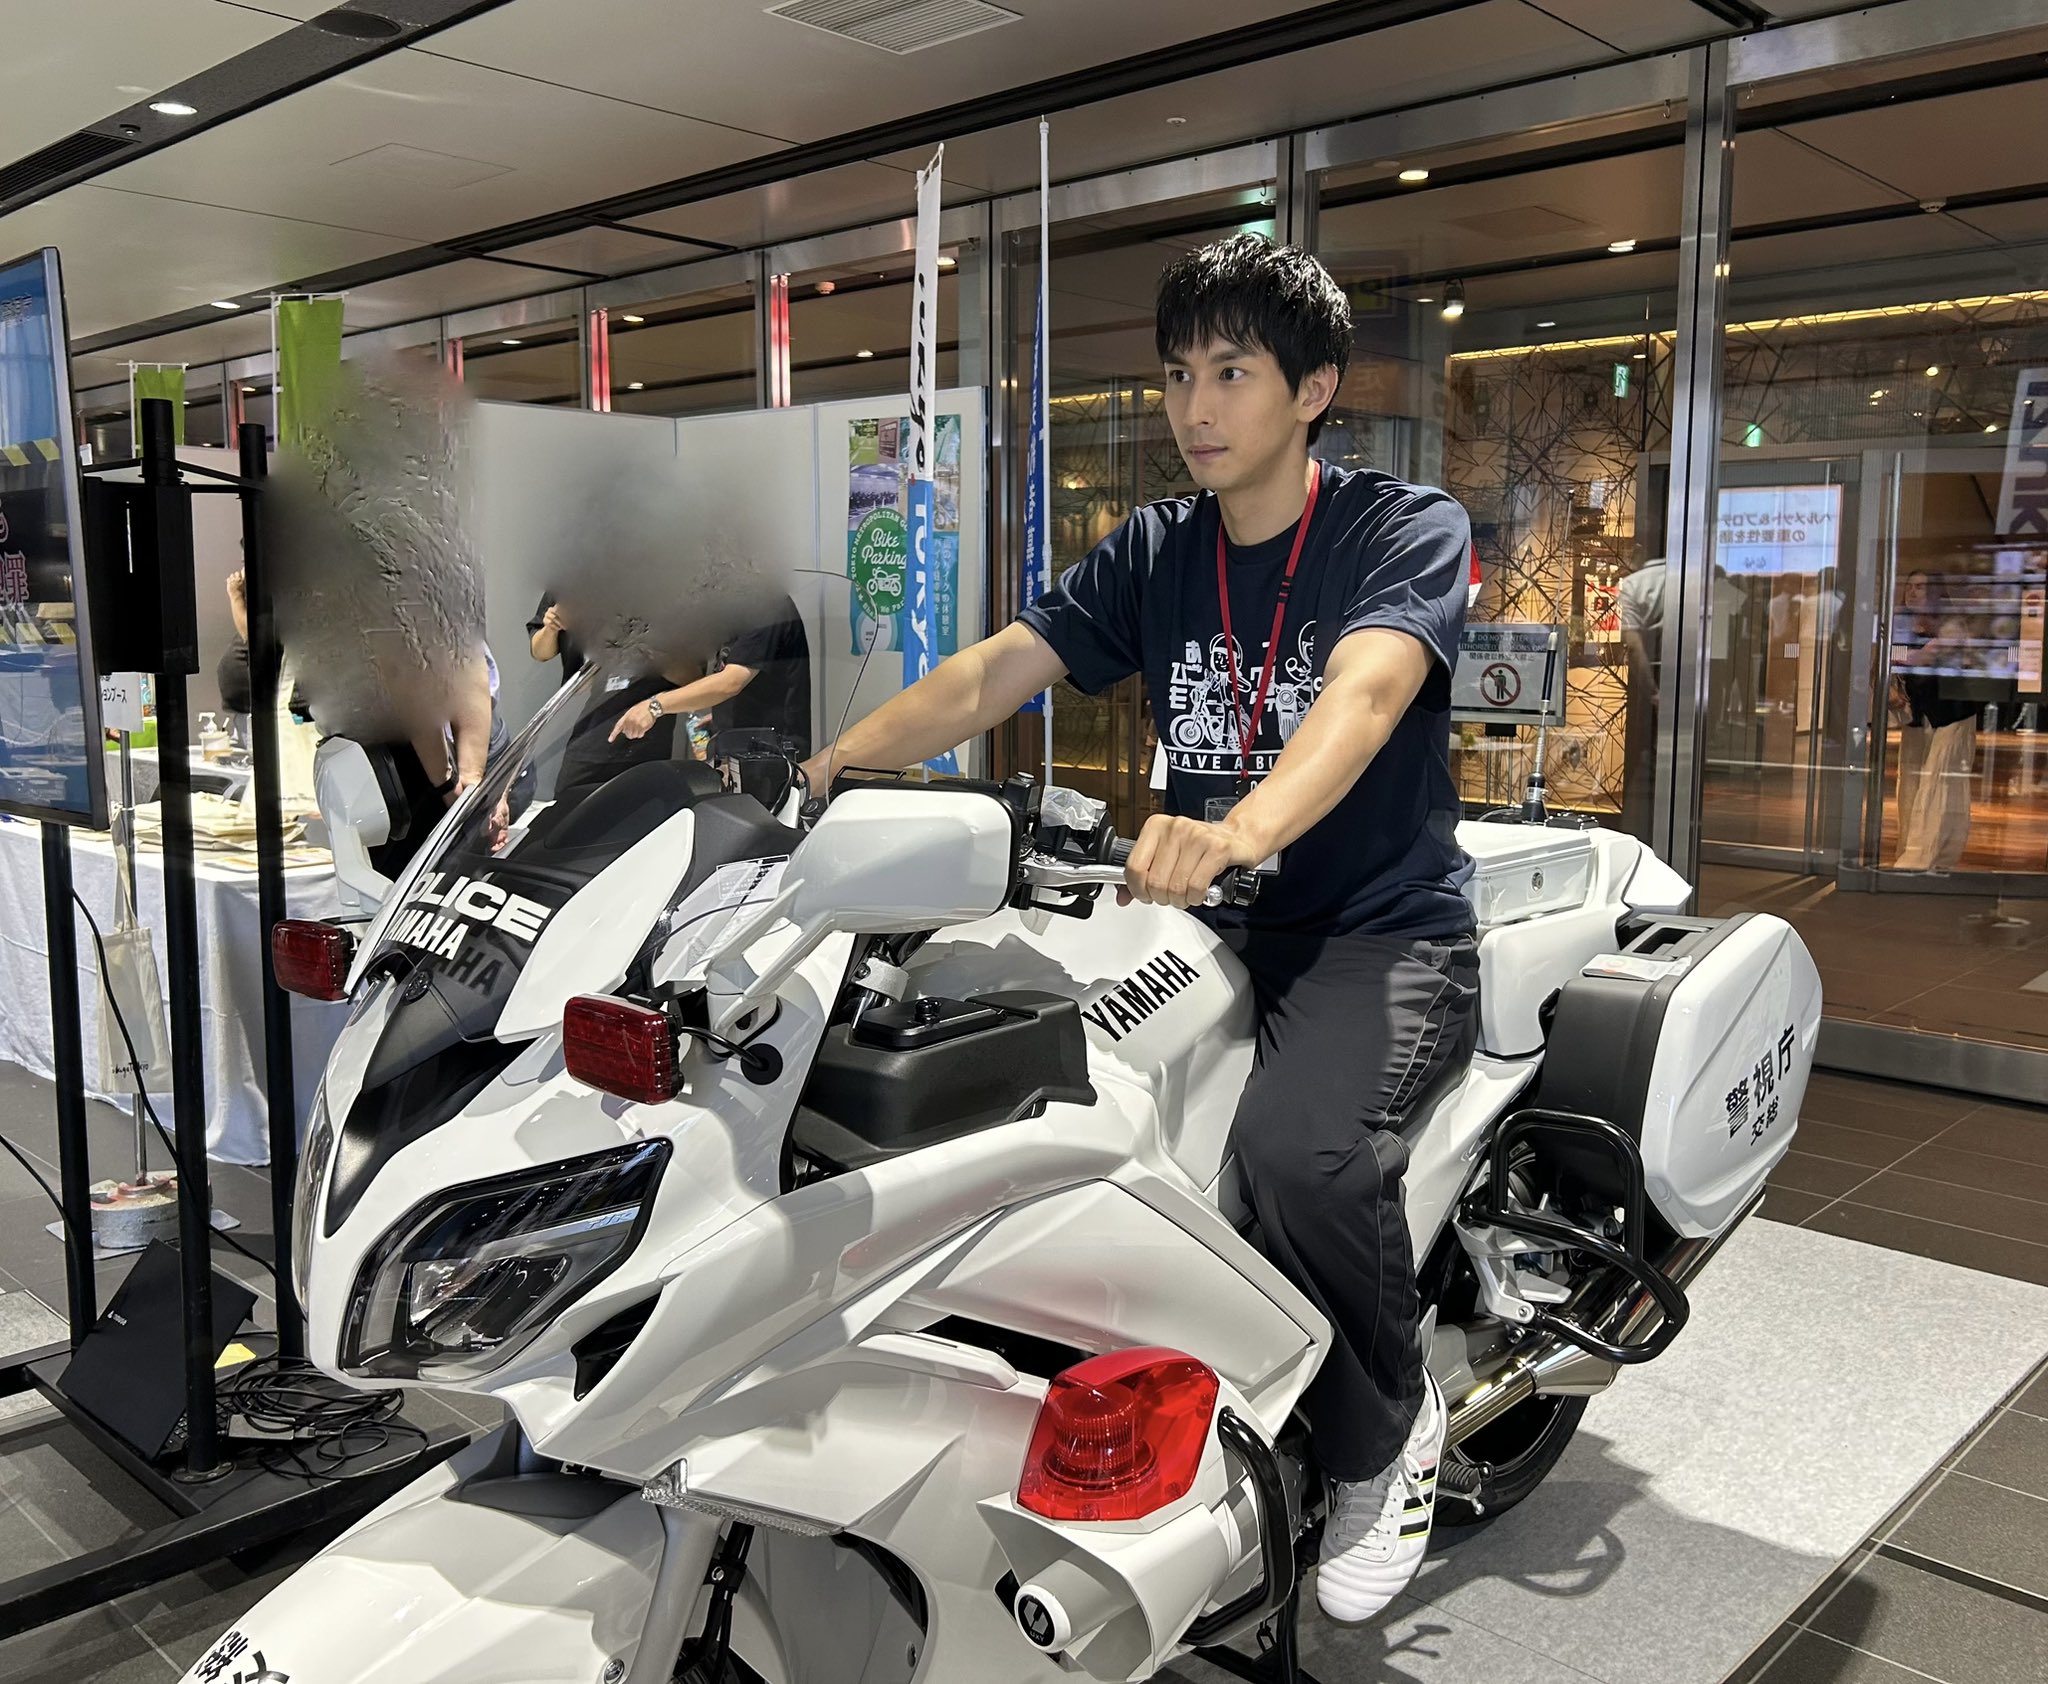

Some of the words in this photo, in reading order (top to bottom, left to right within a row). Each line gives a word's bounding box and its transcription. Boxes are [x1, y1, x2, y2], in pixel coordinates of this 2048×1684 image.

[861, 545, 908, 569] Parking
[871, 527, 900, 548] Bike
[1169, 751, 1221, 769] HAVE
[1234, 756, 1243, 769] A
[406, 872, 552, 942] OLICE
[385, 908, 470, 961] AMAHA
[1080, 949, 1201, 1042] YAMAHA
[1725, 1023, 1795, 1139] 警視庁
